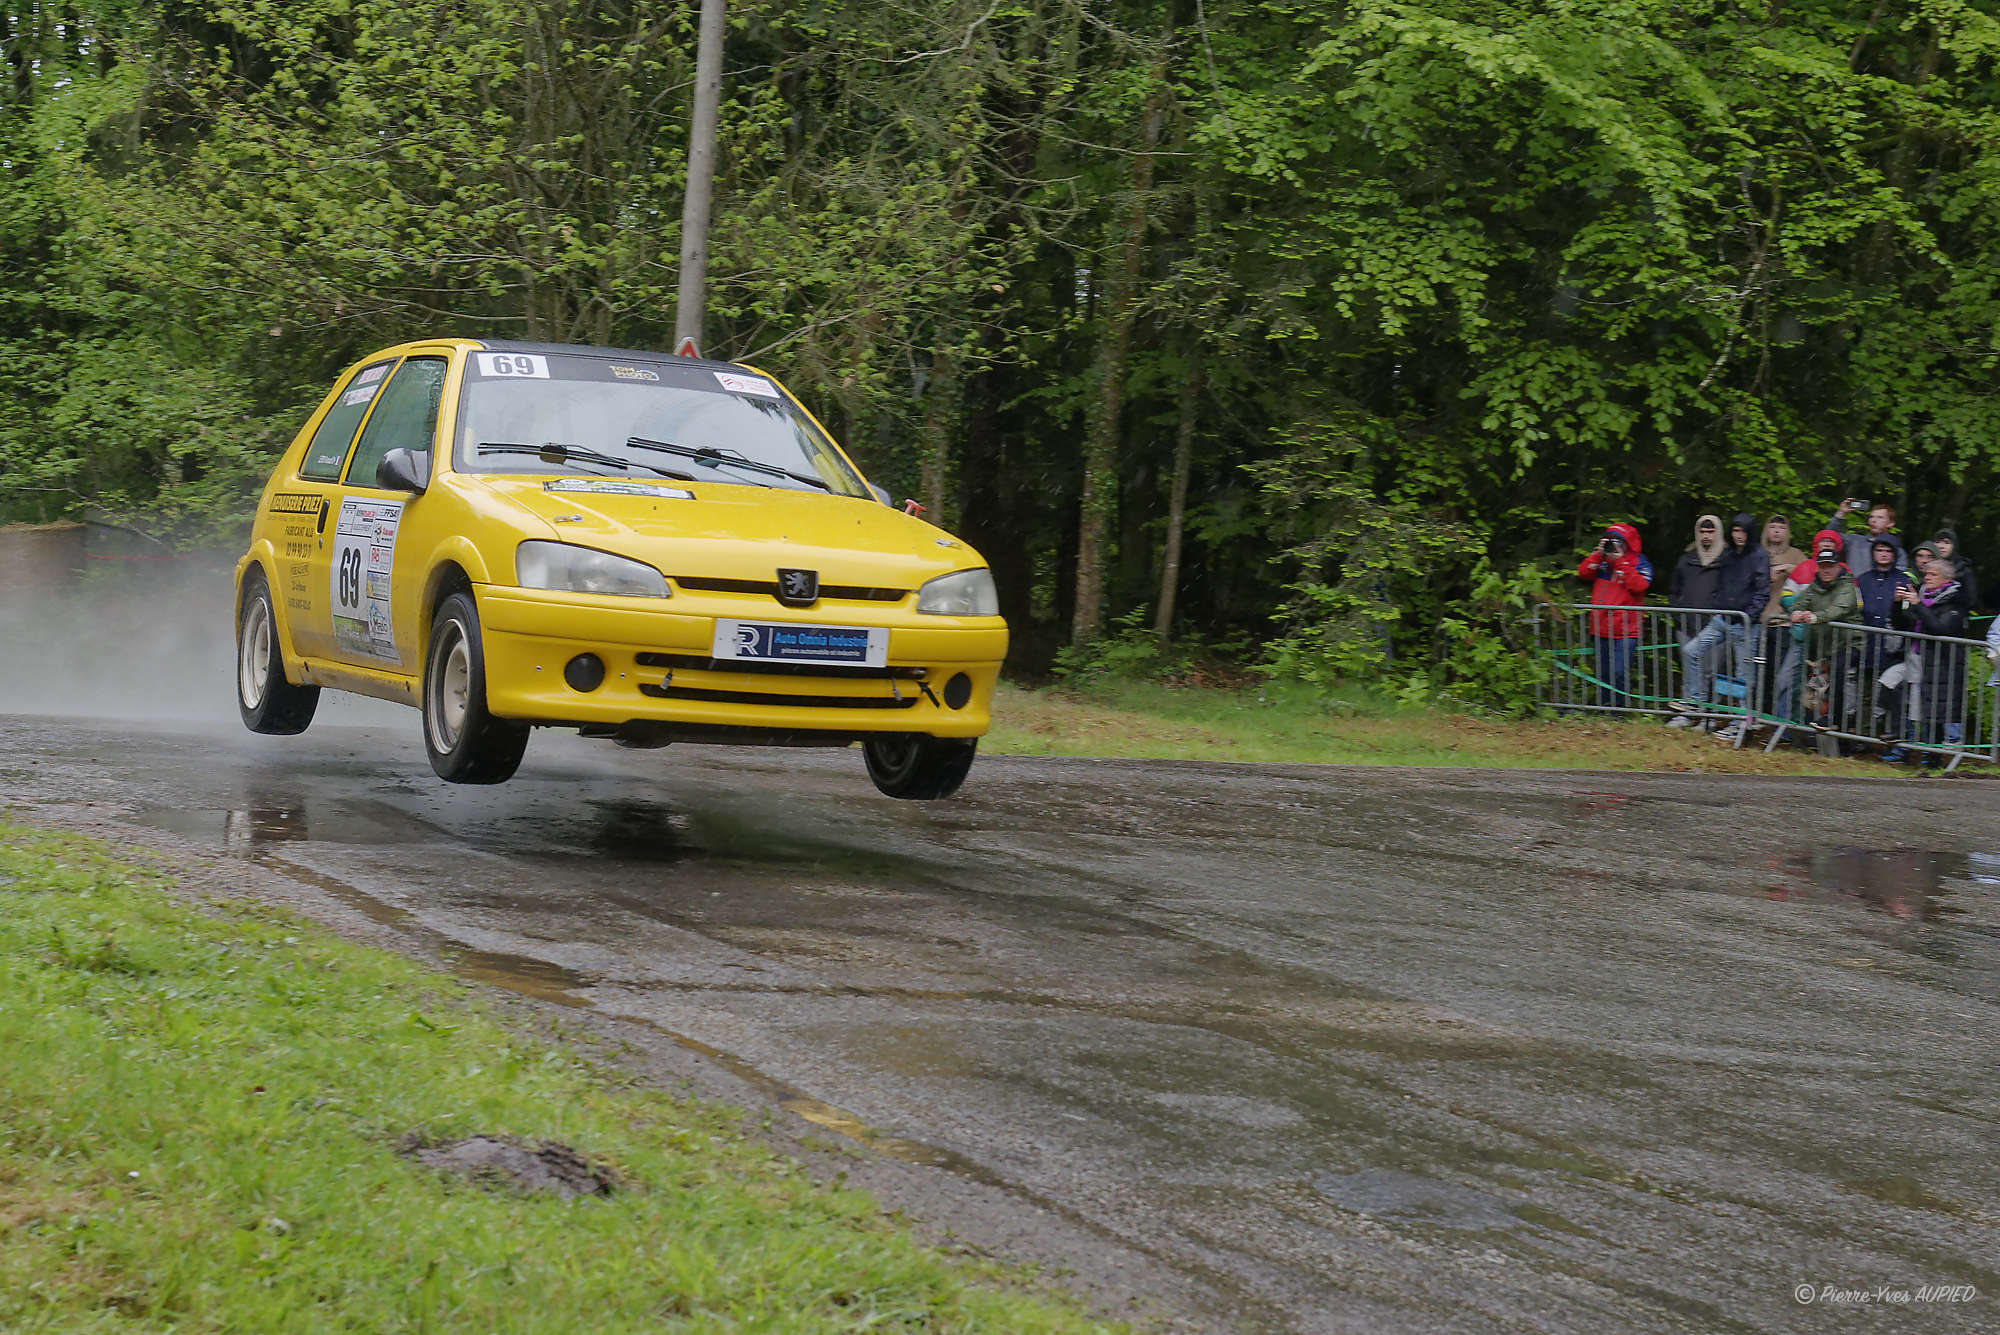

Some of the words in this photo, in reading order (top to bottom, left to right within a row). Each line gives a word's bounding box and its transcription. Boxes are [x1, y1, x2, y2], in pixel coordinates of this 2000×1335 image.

[493, 355, 534, 375] 69
[608, 365, 635, 373] TOM
[614, 371, 653, 379] PHOTO
[340, 547, 361, 608] 69
[775, 631, 797, 645] Auto
